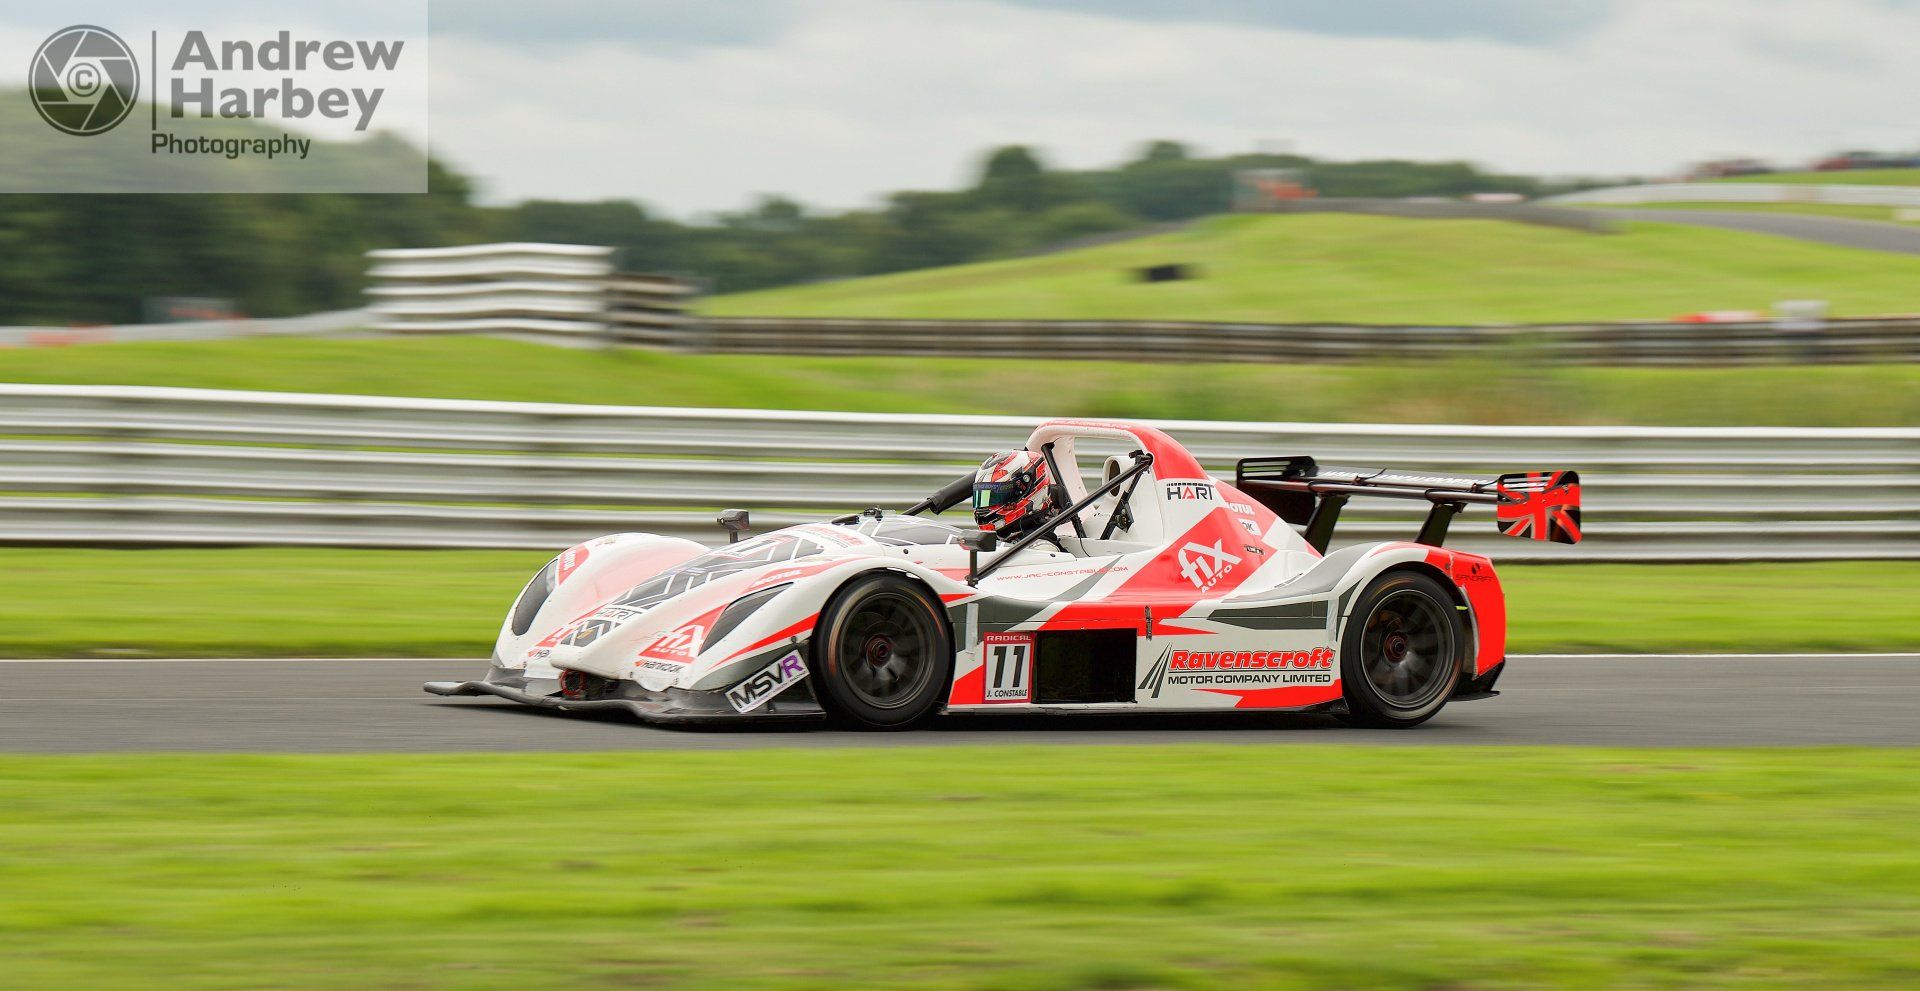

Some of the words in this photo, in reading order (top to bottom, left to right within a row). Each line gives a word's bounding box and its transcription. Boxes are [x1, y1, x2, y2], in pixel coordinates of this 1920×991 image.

[1166, 484, 1214, 501] HART
[1201, 564, 1233, 594] AUTO
[993, 645, 1026, 689] 11
[1169, 646, 1336, 671] Ravenscroft
[729, 655, 804, 709] MSVR
[1168, 675, 1213, 685] MOTOR
[1215, 674, 1281, 684] COMPANY
[1282, 674, 1332, 683] LIMITED
[986, 690, 993, 698] J.
[994, 689, 1028, 698] CONSTABLE
